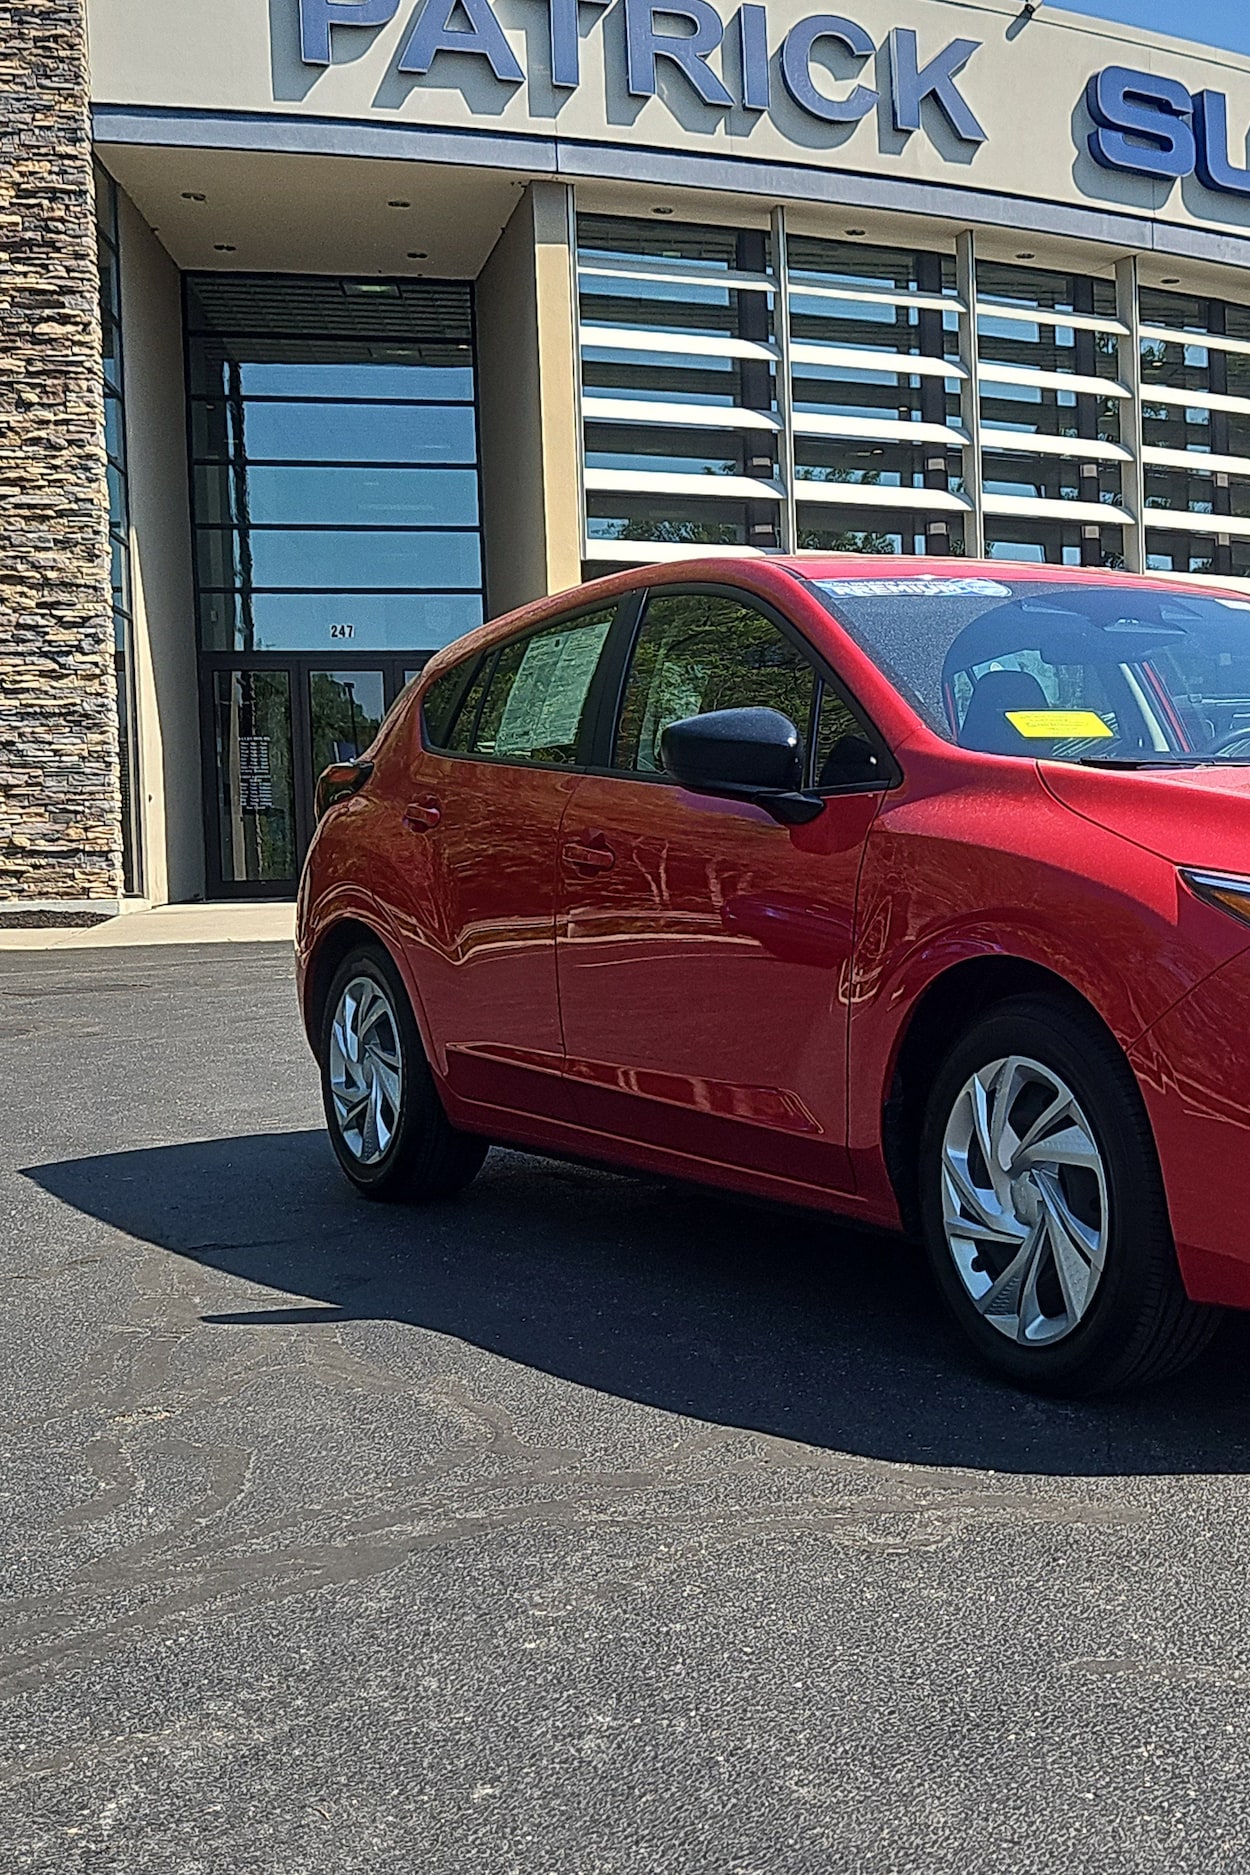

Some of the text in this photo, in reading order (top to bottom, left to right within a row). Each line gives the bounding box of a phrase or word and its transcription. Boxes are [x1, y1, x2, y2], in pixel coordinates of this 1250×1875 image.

[300, 0, 989, 142] PATRICK
[834, 582, 960, 596] PREMIUM
[331, 624, 353, 638] 247
